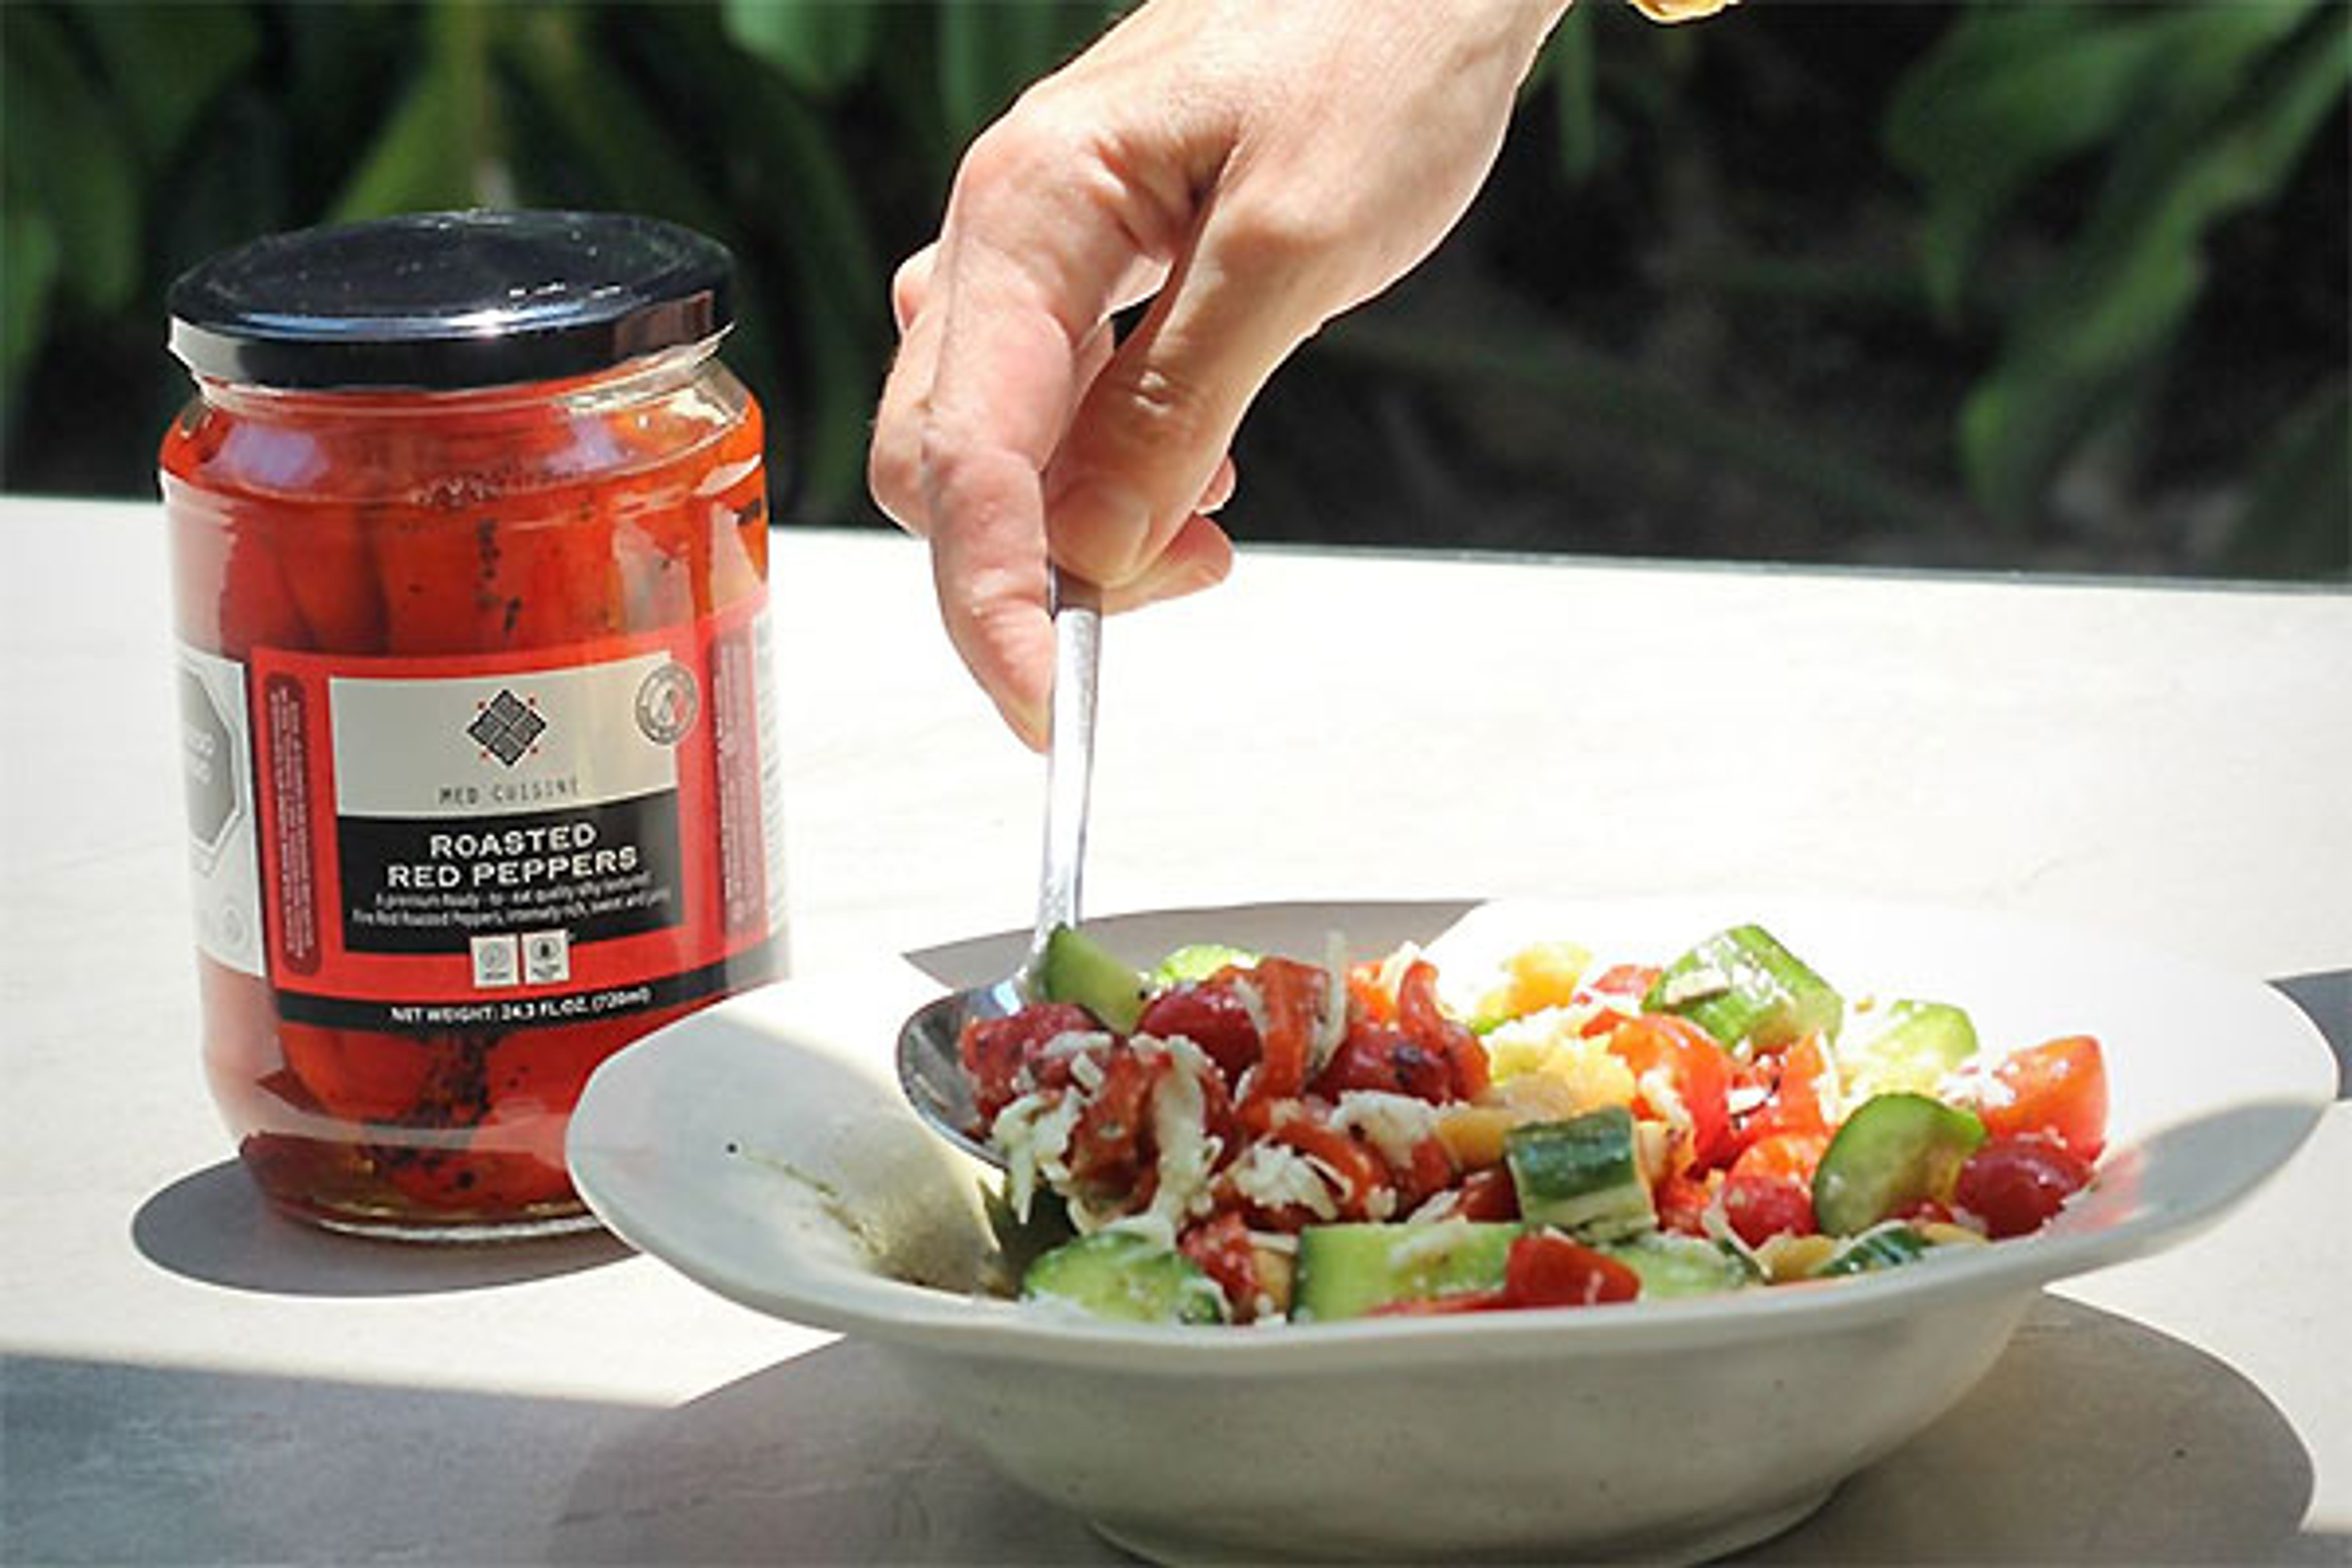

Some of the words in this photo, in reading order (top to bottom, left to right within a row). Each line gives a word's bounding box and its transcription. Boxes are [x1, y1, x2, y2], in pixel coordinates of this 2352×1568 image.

[439, 786, 479, 805] MED
[491, 775, 578, 802] CUISINE
[430, 823, 597, 858] ROASTED
[387, 865, 462, 888] RED
[473, 846, 638, 888] PEPPERS
[391, 1006, 421, 1024] NET
